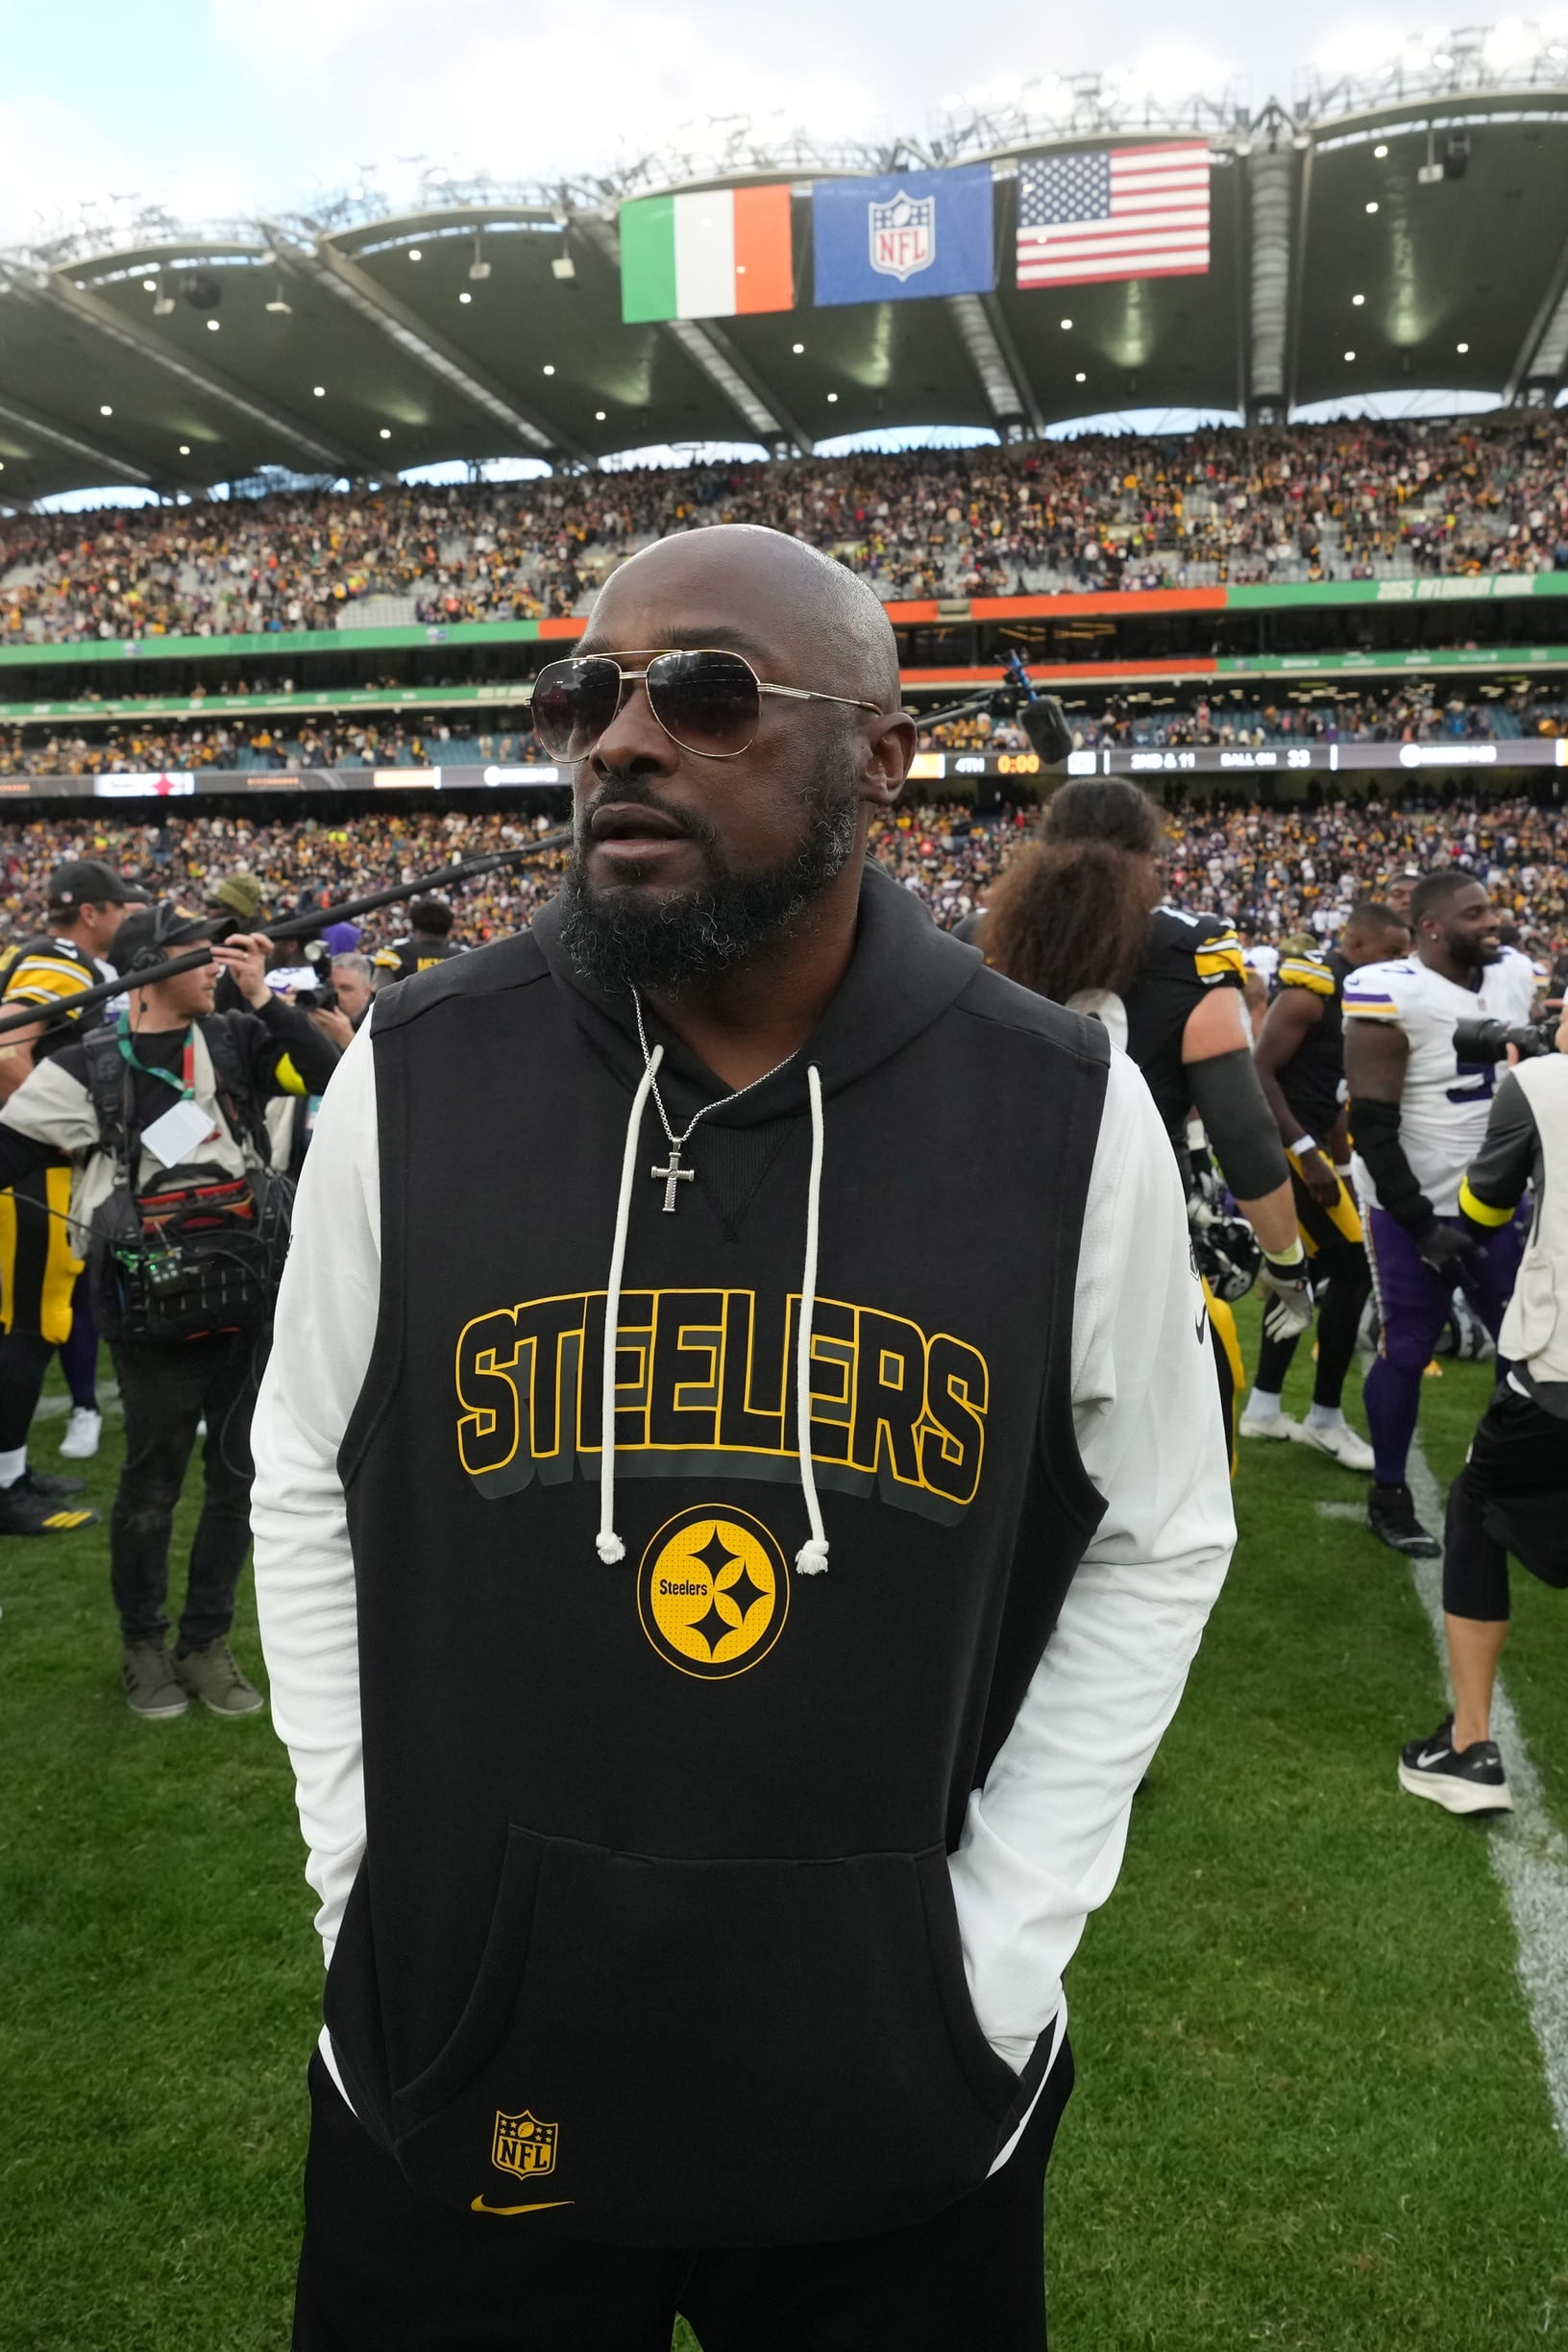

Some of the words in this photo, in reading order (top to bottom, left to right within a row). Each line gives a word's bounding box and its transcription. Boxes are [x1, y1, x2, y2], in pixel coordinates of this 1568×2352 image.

[880, 231, 926, 265] NFL
[997, 754, 1040, 773] 0:00
[1131, 753, 1164, 769] 2ND
[1179, 752, 1195, 768] 11
[1287, 749, 1311, 768] 33
[455, 1288, 989, 1505] STEELERS
[659, 1579, 708, 1596] Steelers
[500, 2139, 549, 2169] NFL
